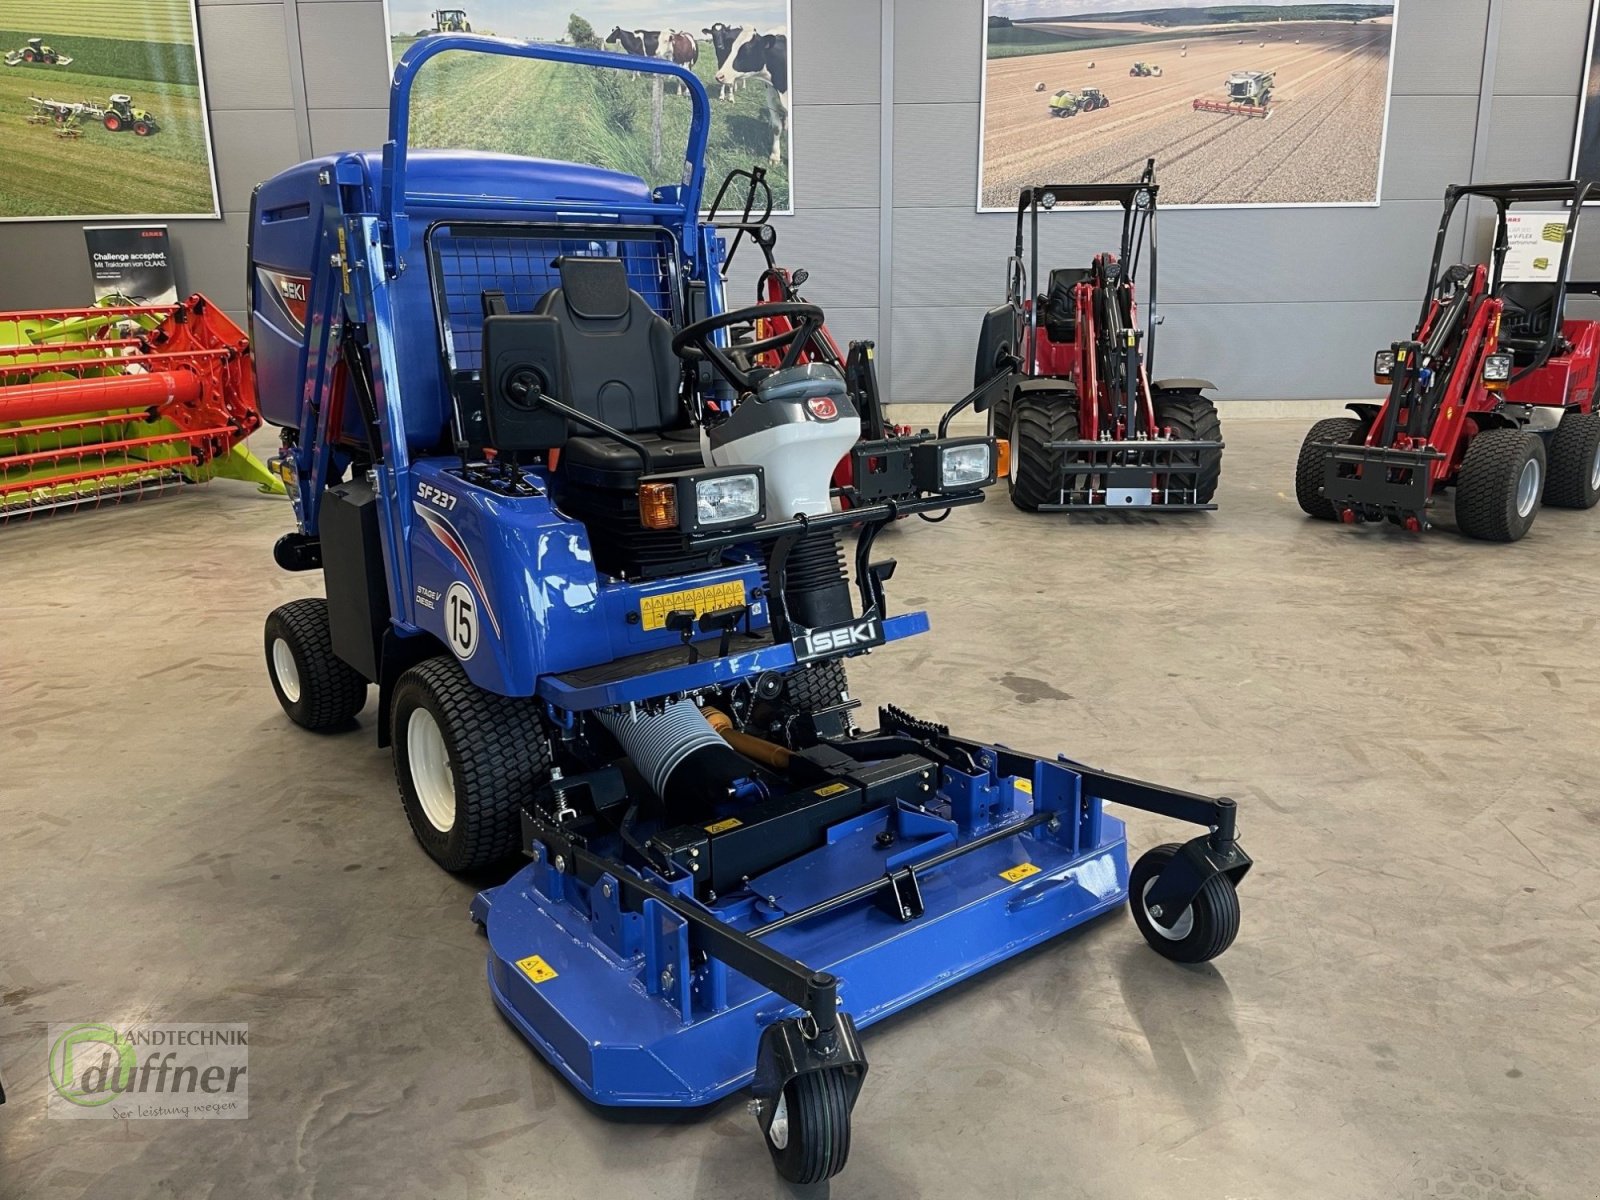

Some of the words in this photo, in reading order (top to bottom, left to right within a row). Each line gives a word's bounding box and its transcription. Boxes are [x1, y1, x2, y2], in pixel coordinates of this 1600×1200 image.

[93, 253, 129, 261] Challenge
[130, 252, 167, 260] accepted.
[416, 481, 457, 511] SF237
[416, 595, 435, 610] DIESEL
[417, 585, 436, 600] STAGE
[450, 594, 472, 650] 15
[804, 621, 877, 654] ISEKI
